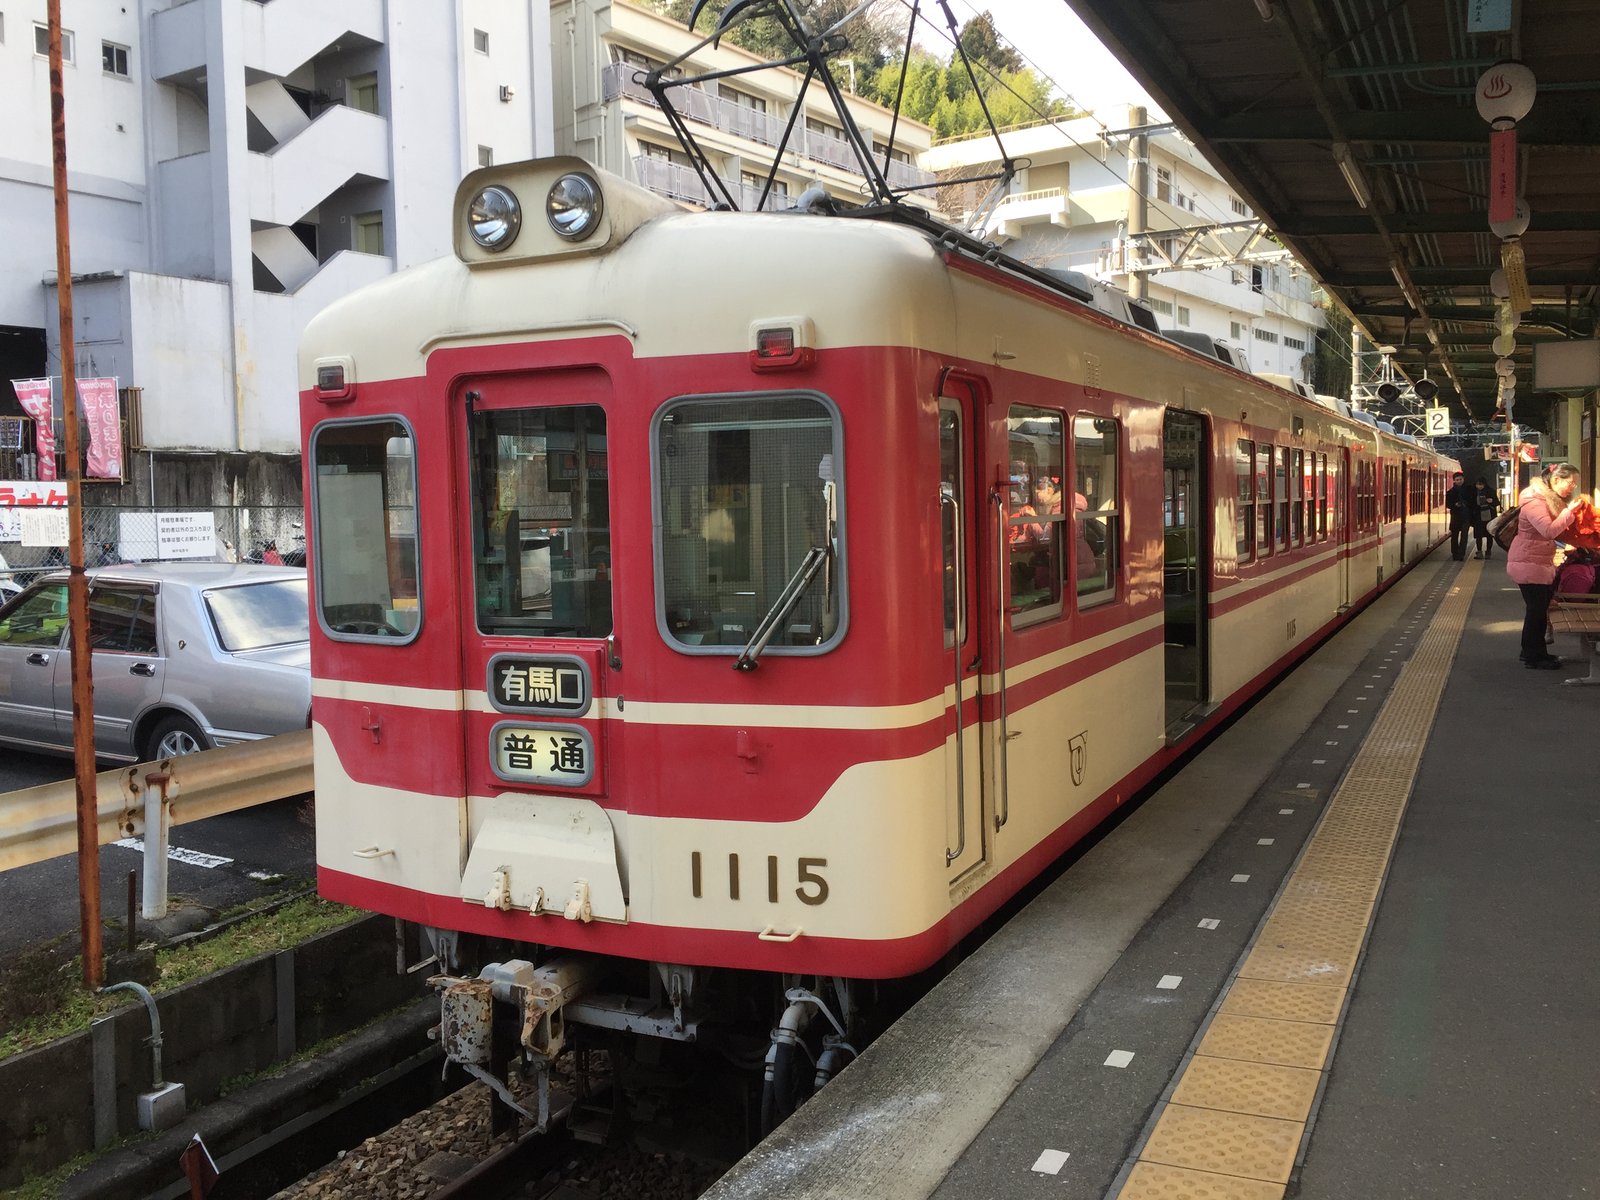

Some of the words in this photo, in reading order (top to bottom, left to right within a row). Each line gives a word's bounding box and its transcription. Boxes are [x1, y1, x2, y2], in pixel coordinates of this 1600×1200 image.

[1432, 413, 1444, 430] 2
[501, 665, 583, 703] 有馬口
[503, 733, 585, 774] 普通
[691, 851, 829, 905] 1115
